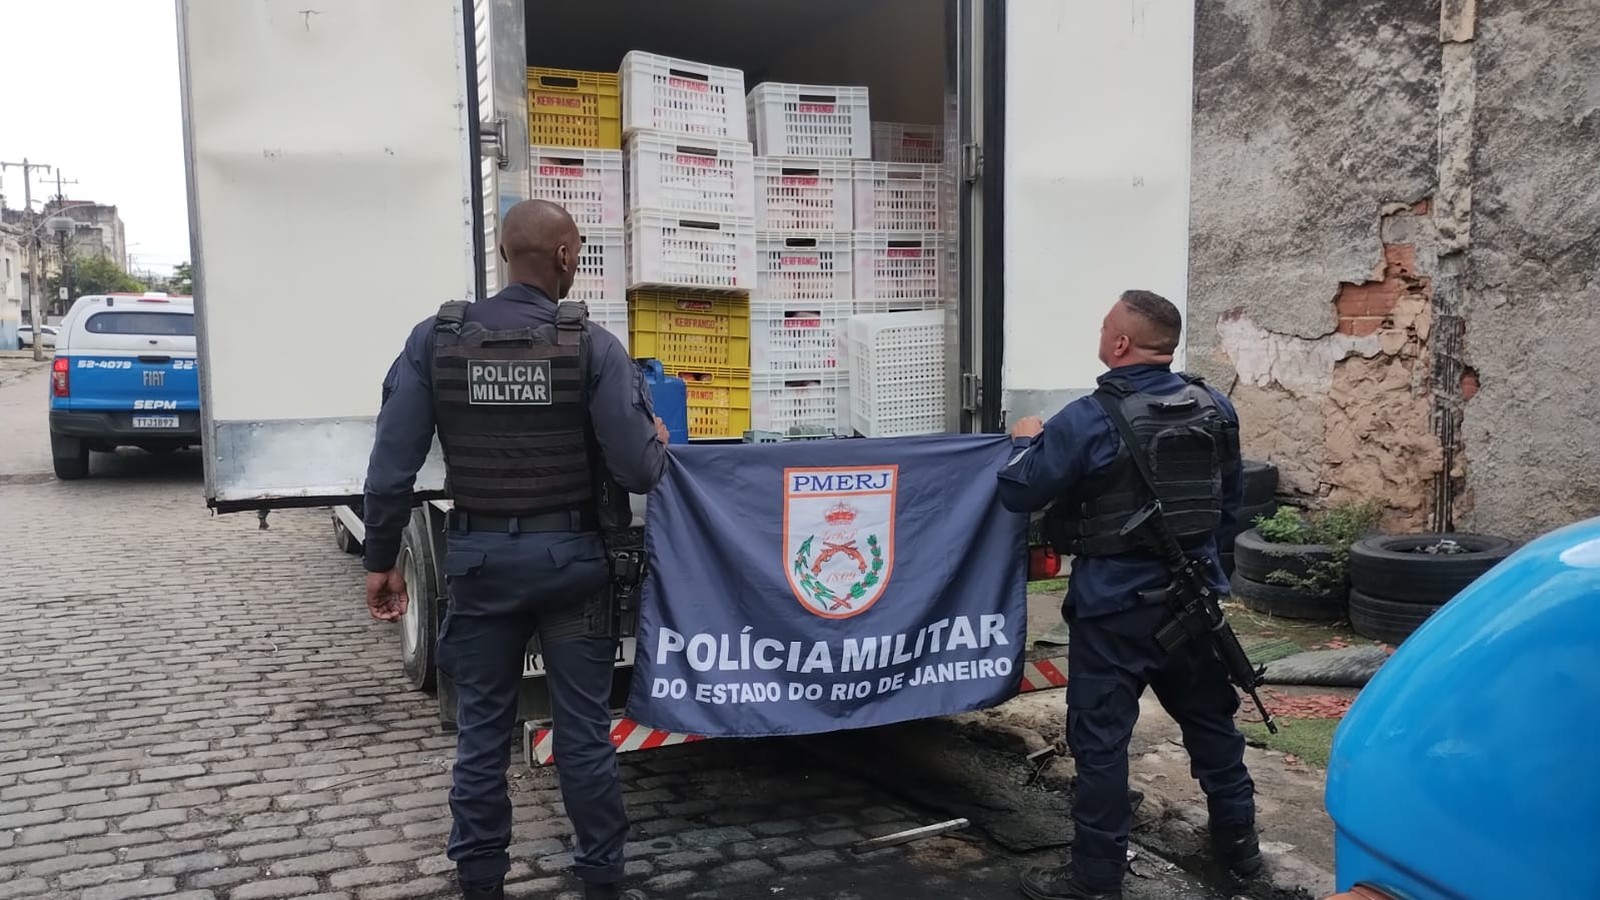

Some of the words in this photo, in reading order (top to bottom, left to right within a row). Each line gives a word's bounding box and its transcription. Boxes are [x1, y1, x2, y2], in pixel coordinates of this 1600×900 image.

[669, 76, 709, 93] KERFRANGO
[537, 95, 581, 108] KERFRANGO
[676, 154, 716, 168] KERFRANGO
[539, 166, 583, 177] KERFRANGO
[780, 256, 819, 266] KERFRANGO
[675, 317, 716, 330] KERFRANGO
[77, 360, 132, 369] 52-4079
[143, 370, 165, 387] FIAT
[472, 362, 546, 382] POLÍCIA
[473, 384, 547, 400] MILITAR
[687, 390, 714, 400] FRANGO
[133, 400, 177, 410] SEPM
[792, 473, 890, 492] PMERJ
[655, 625, 835, 674] POLÍCIA
[840, 613, 1010, 674] MILITAR
[651, 677, 688, 699] DO
[695, 682, 782, 704] ESTADO
[788, 681, 824, 701] DO
[830, 676, 873, 701] RIO
[876, 673, 905, 695] DE
[908, 656, 1013, 687] JANEIRO
